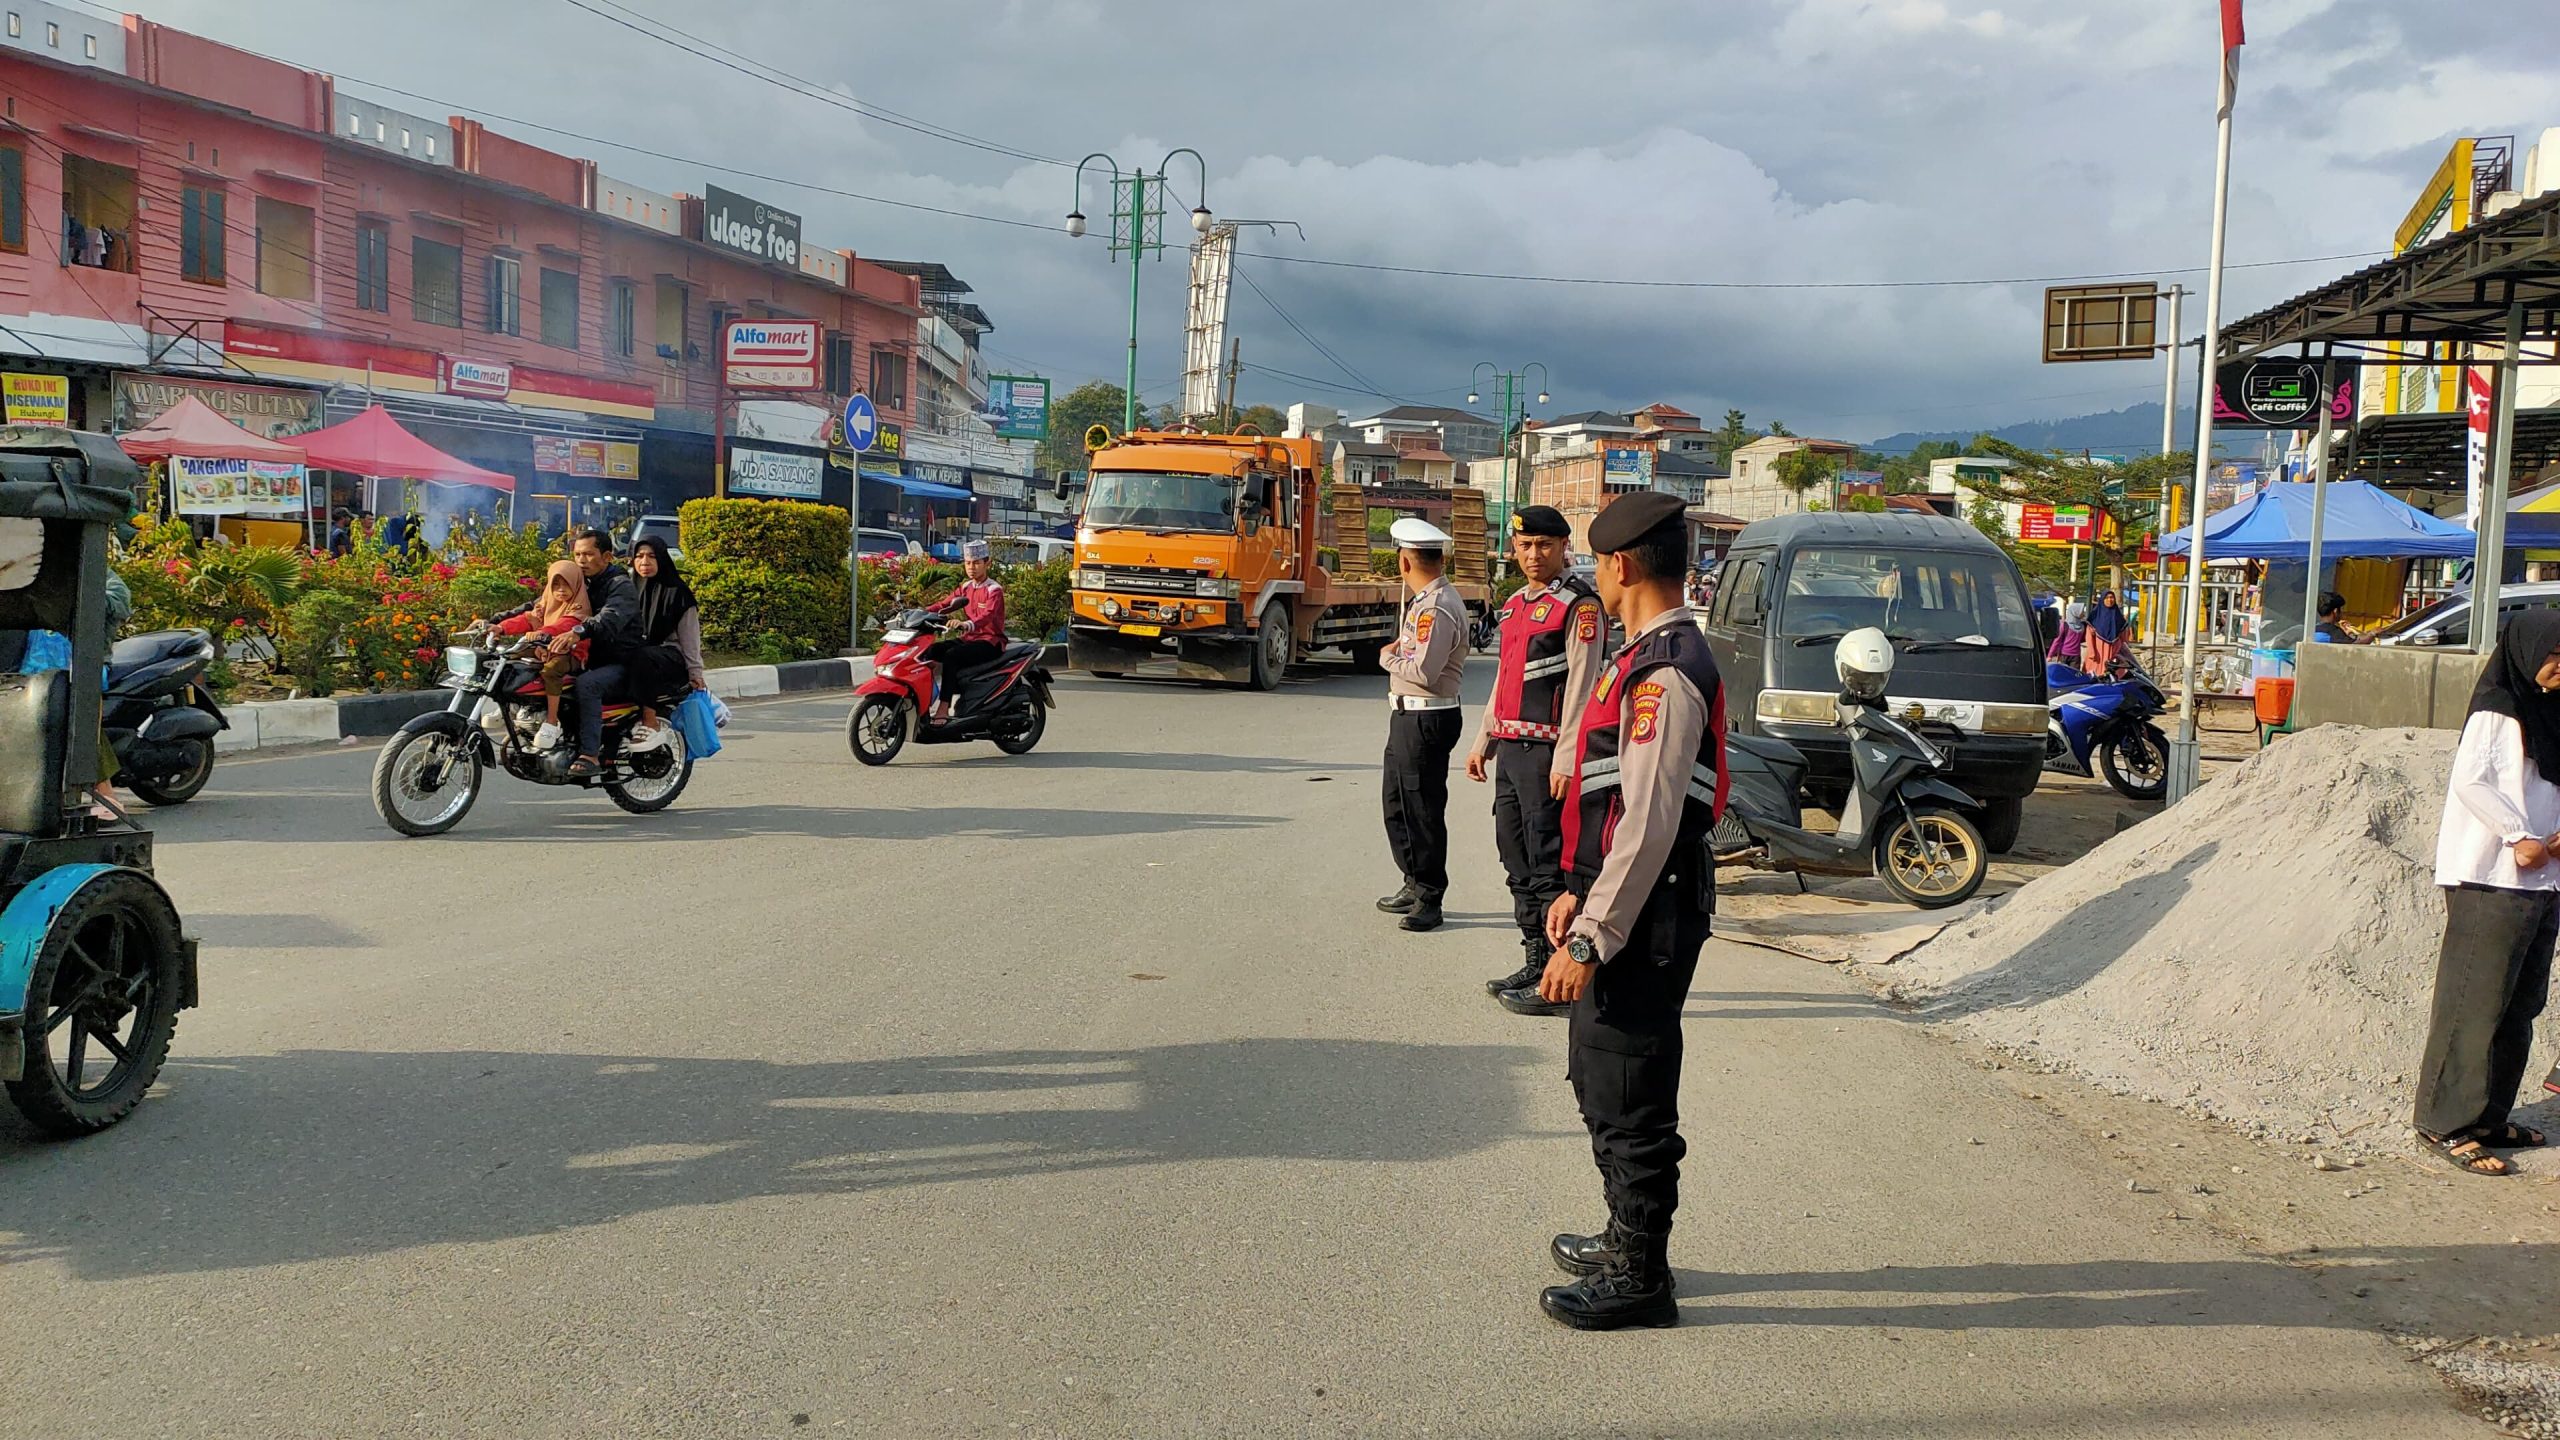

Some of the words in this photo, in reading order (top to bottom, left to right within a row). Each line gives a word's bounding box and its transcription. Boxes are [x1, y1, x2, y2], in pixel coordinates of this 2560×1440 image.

[710, 207, 762, 255] ulaez
[767, 223, 796, 265] foe
[733, 328, 808, 345] Alfamart
[455, 364, 507, 385] Alfamart
[5, 394, 66, 408] DISEWAKAN
[231, 390, 310, 419] SULTAN
[880, 426, 899, 448] foe
[739, 460, 766, 480] UDA
[768, 463, 815, 485] SAYANG
[915, 466, 937, 482] TAJUK
